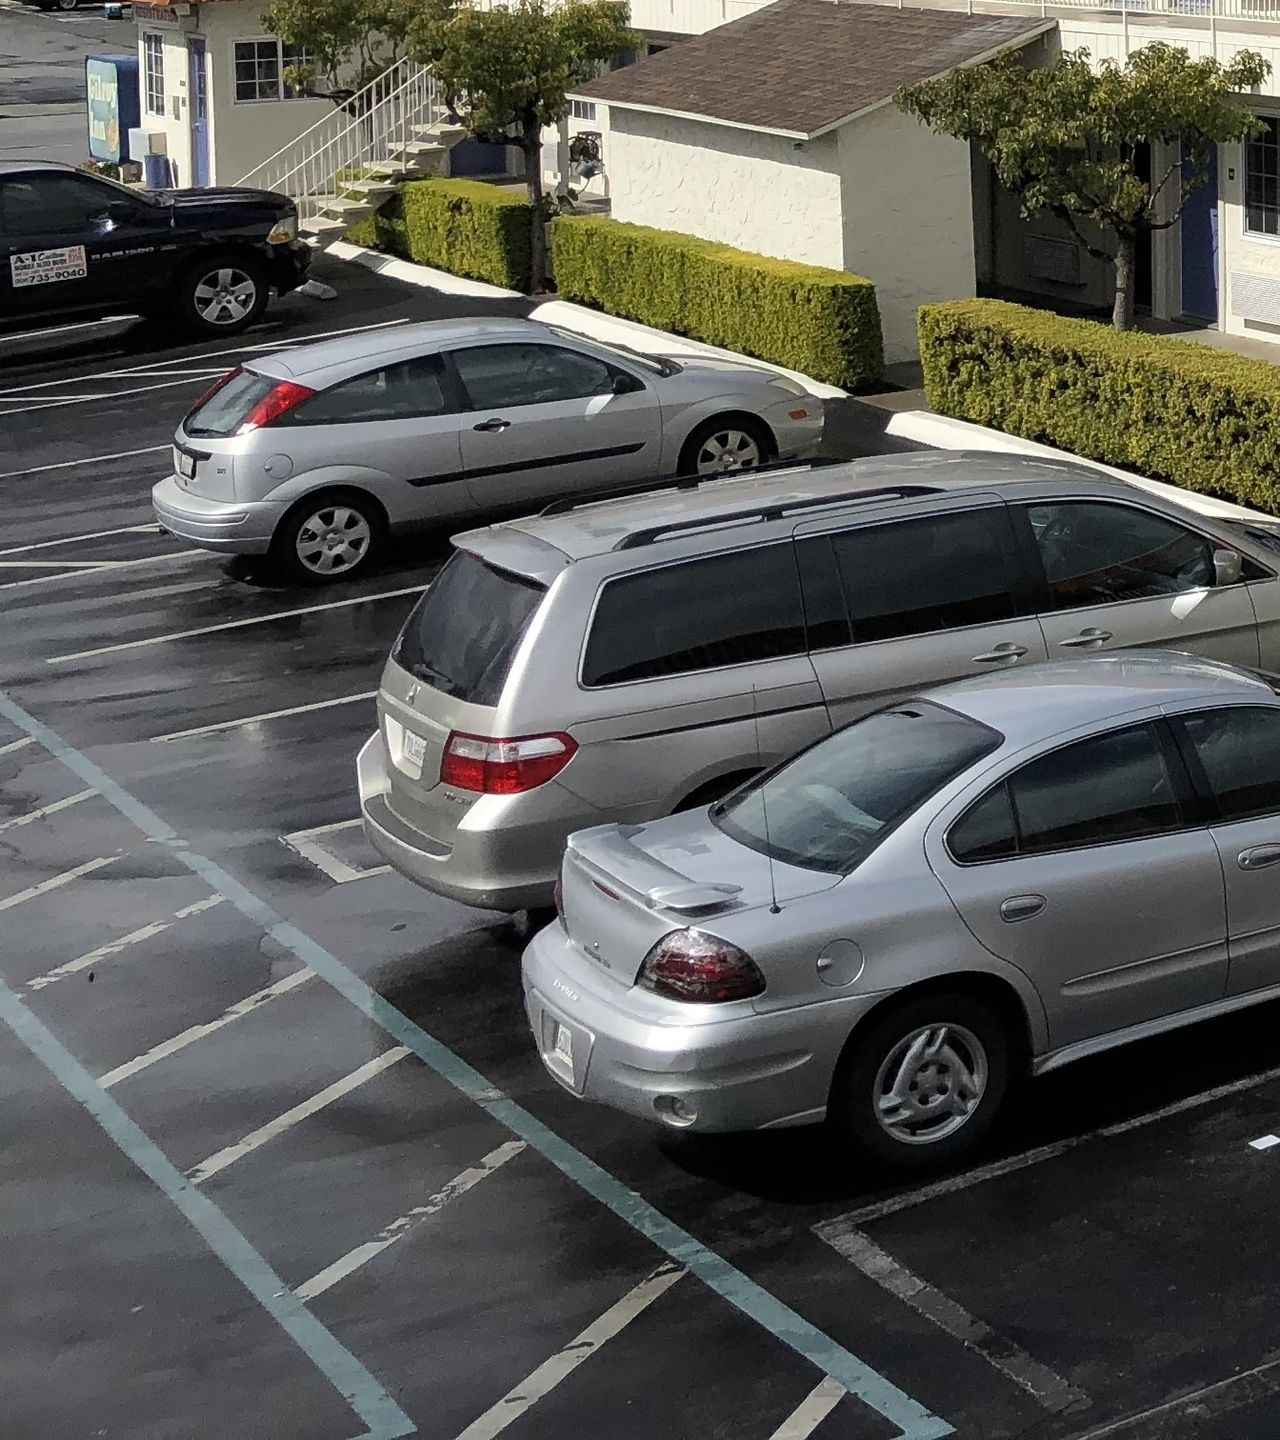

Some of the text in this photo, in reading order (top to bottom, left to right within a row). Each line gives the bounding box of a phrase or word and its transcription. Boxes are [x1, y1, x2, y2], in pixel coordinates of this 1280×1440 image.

[88, 73, 118, 109] Gilroy
[89, 111, 106, 141] Inn
[29, 268, 86, 283] 735-9040
